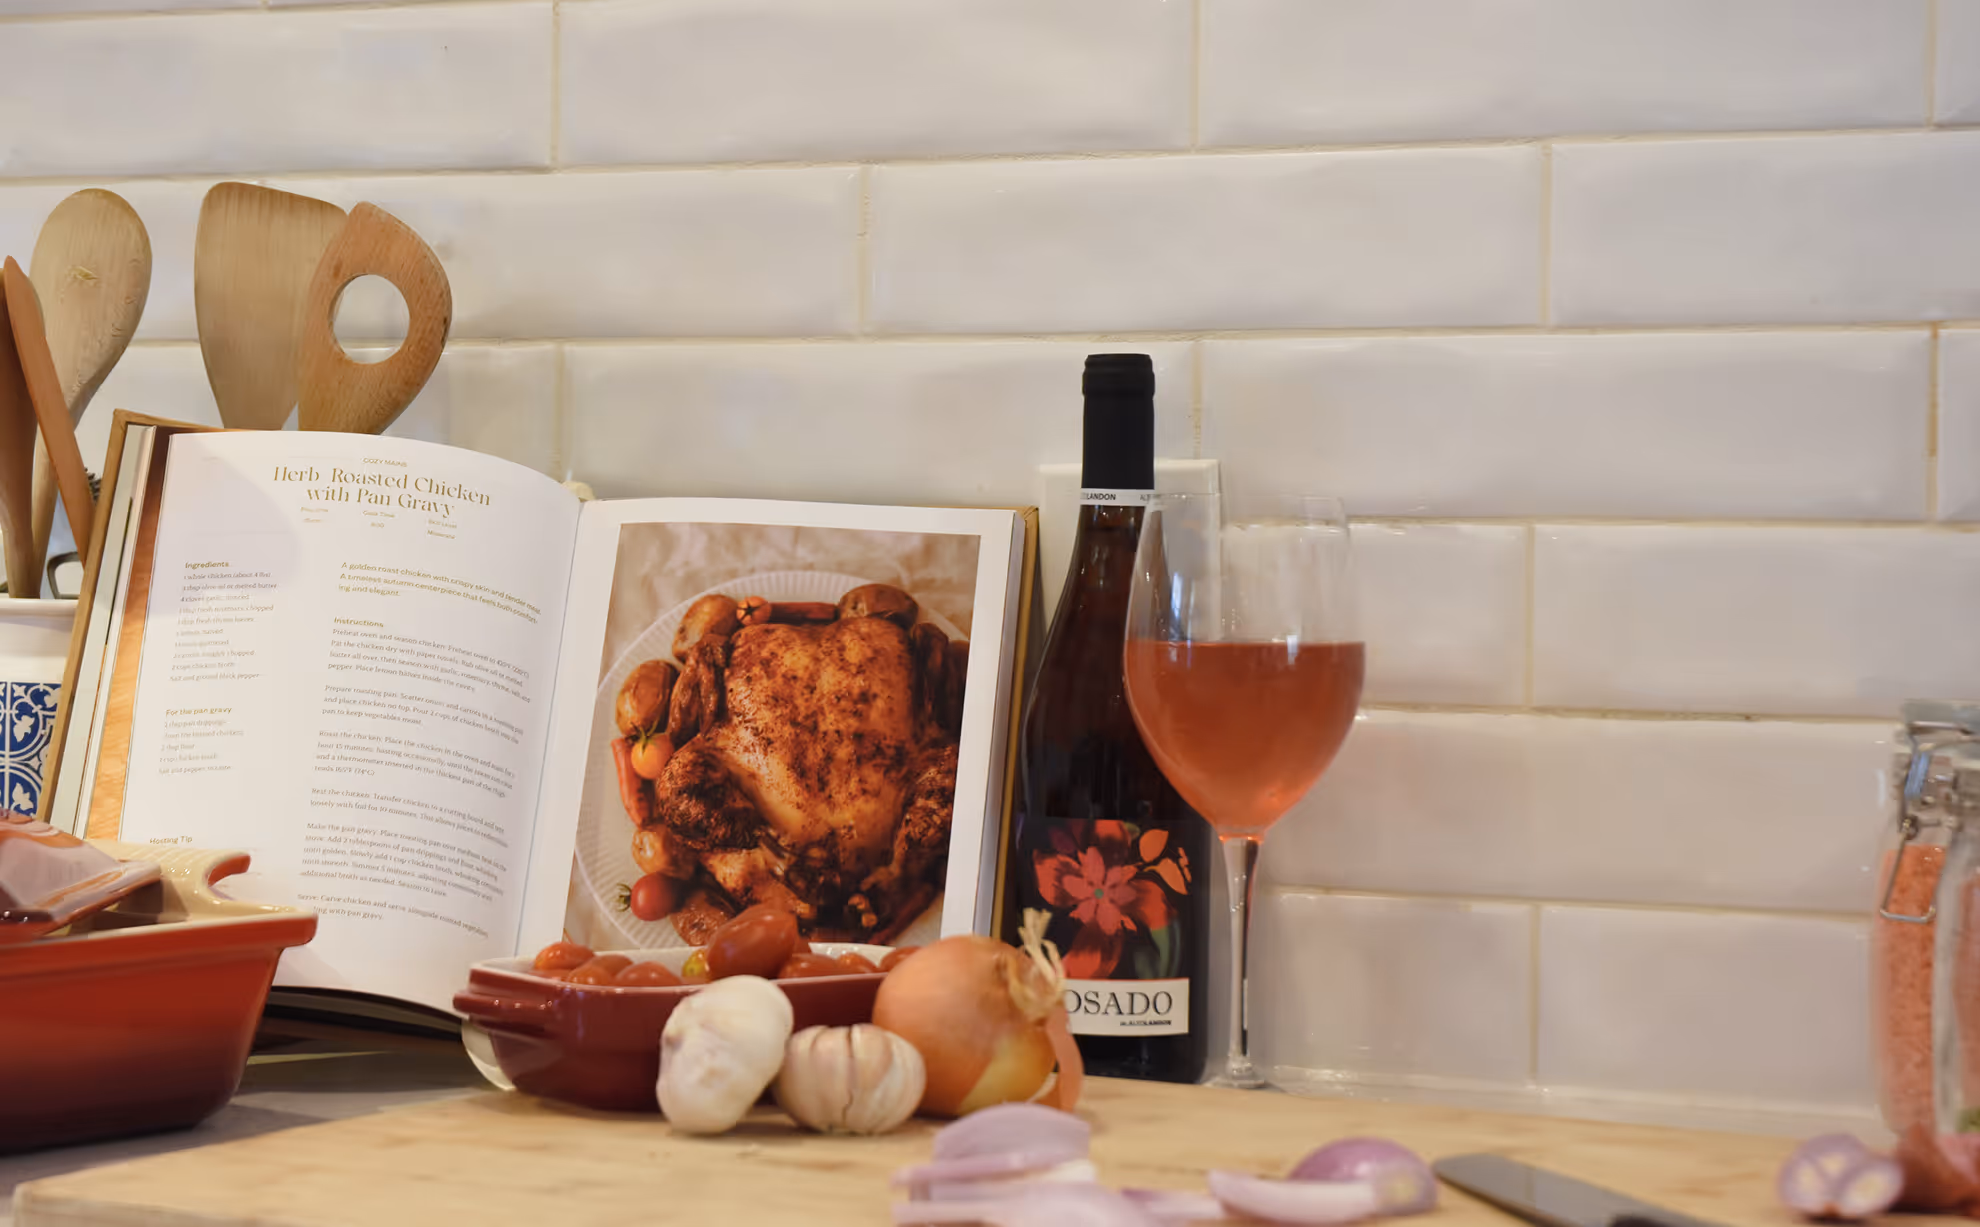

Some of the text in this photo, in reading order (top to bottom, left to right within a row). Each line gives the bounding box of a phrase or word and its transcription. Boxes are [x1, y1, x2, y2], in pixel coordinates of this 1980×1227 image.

[274, 467, 490, 505] Herb Roasted Chicken
[306, 486, 455, 518] with Pan Gravy
[185, 562, 229, 570] Ingredients
[349, 563, 377, 571] golden
[378, 566, 399, 574] roast
[401, 568, 431, 578] chicken
[433, 575, 449, 583] with
[475, 584, 489, 592] skin
[339, 584, 350, 592] ing
[352, 585, 368, 593] and
[463, 592, 477, 601] that
[334, 617, 384, 627] Instructions
[357, 642, 384, 651] chicken
[399, 647, 415, 655] with
[359, 700, 386, 708] chicken
[1065, 989, 1172, 1015] OSADO
